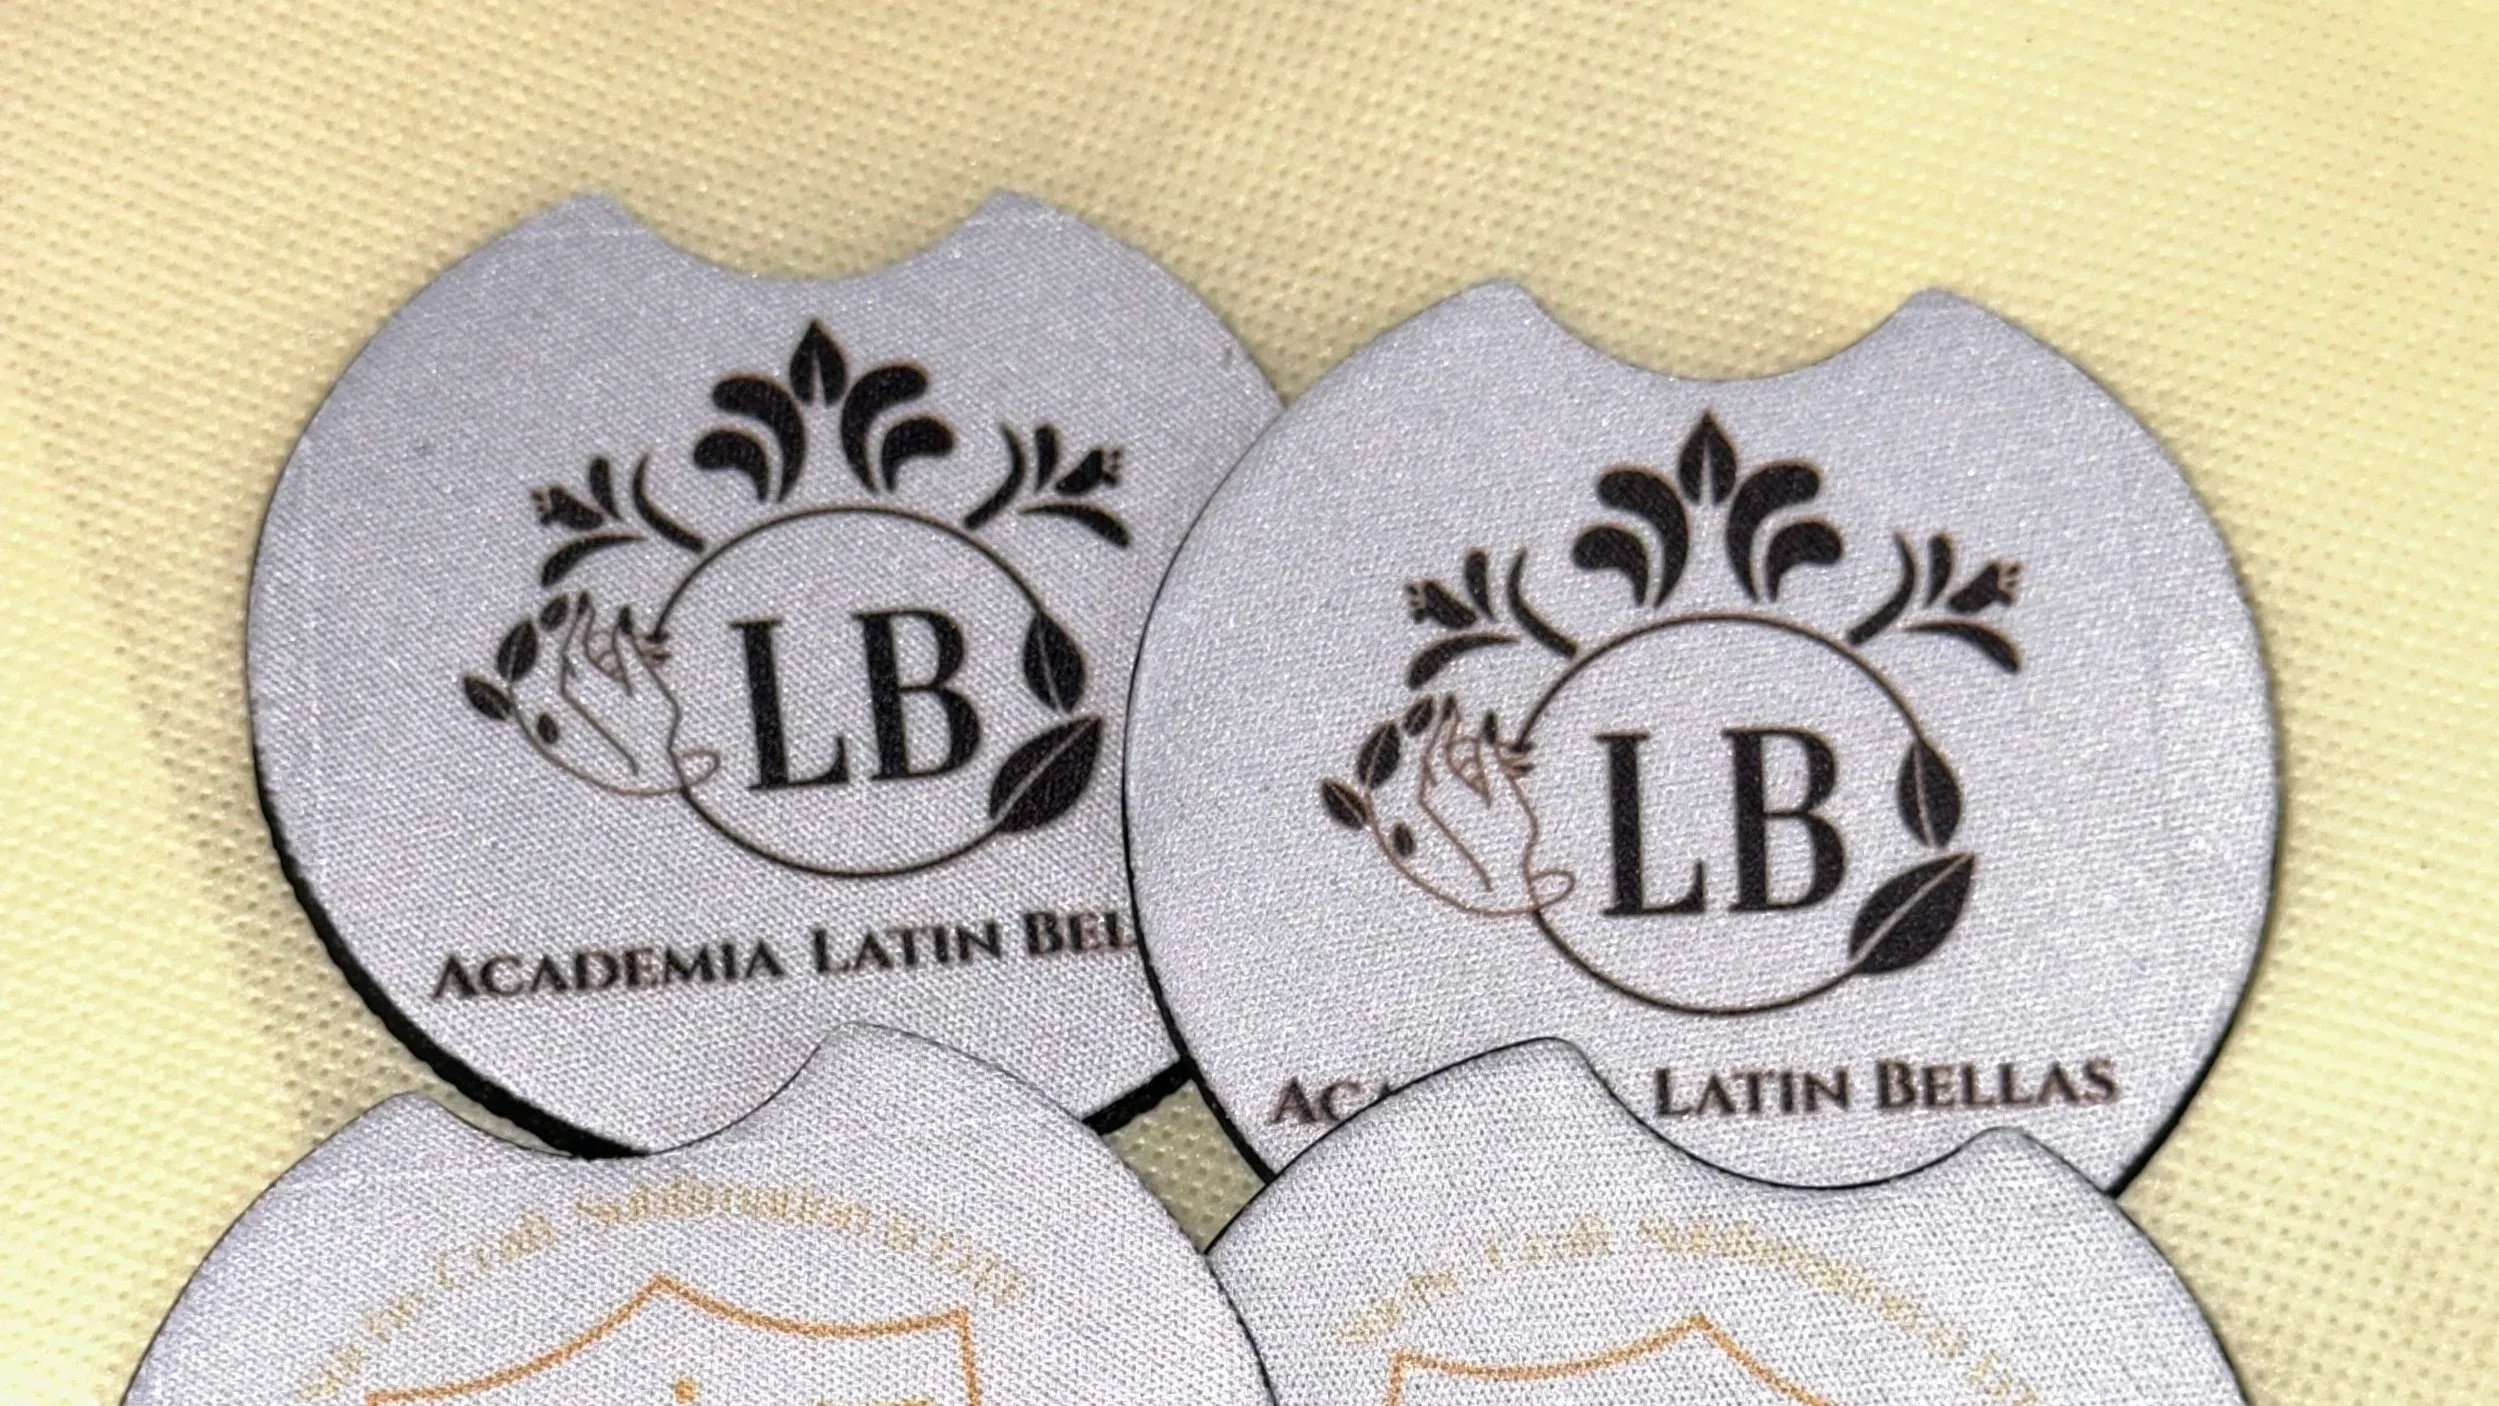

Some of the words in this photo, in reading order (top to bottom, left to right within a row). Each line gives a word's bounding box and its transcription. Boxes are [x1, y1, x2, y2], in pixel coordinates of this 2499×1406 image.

[729, 607, 983, 793] LB
[1595, 726, 1848, 918] LB
[431, 937, 786, 1001] ACADEMIA
[810, 919, 1003, 976] LATIN
[1021, 909, 1139, 958] BEL
[1654, 1067, 1850, 1119] LATIN
[1875, 1060, 2117, 1113] BELLAS
